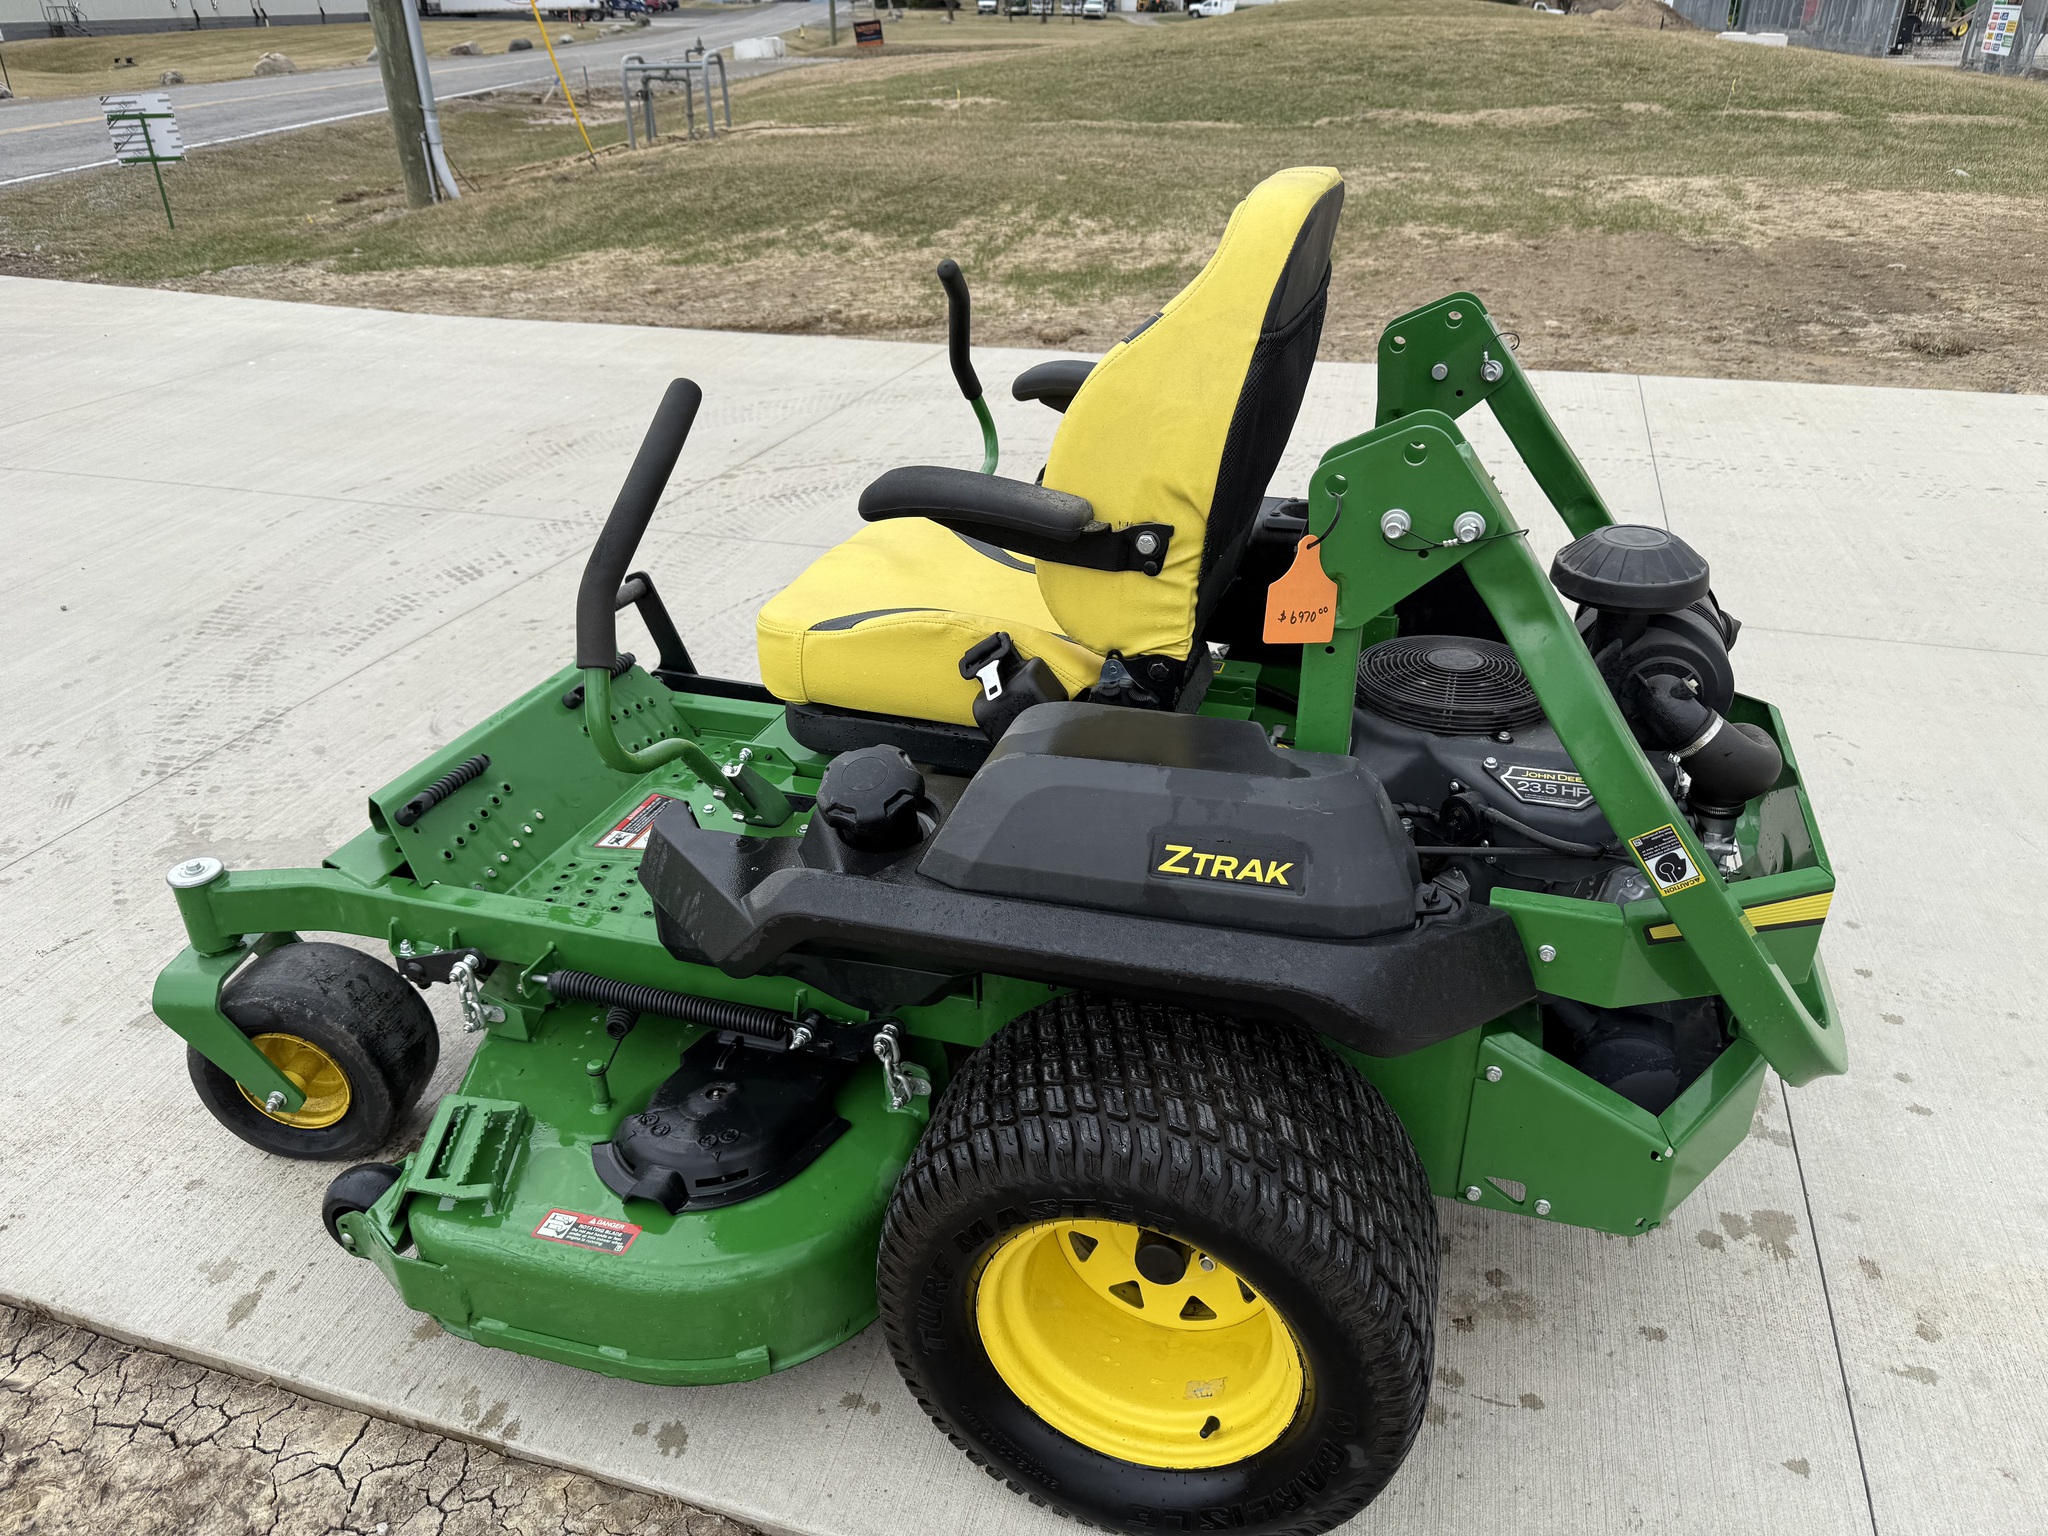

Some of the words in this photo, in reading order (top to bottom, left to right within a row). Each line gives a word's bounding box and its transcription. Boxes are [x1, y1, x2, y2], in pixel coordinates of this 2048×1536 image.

[1521, 770, 1555, 780] JOHN
[1558, 774, 1585, 783] DEE
[1517, 781, 1557, 794] 23.5
[1561, 785, 1590, 797] HP
[1158, 844, 1295, 886] ZTRAK
[1664, 879, 1695, 894] CAUTION
[578, 1224, 605, 1233] ROTATING
[596, 1220, 625, 1230] DANGER
[918, 1250, 956, 1355] TURF
[952, 1198, 1176, 1255] MASTER
[1127, 1437, 1347, 1533] CARLISLE
